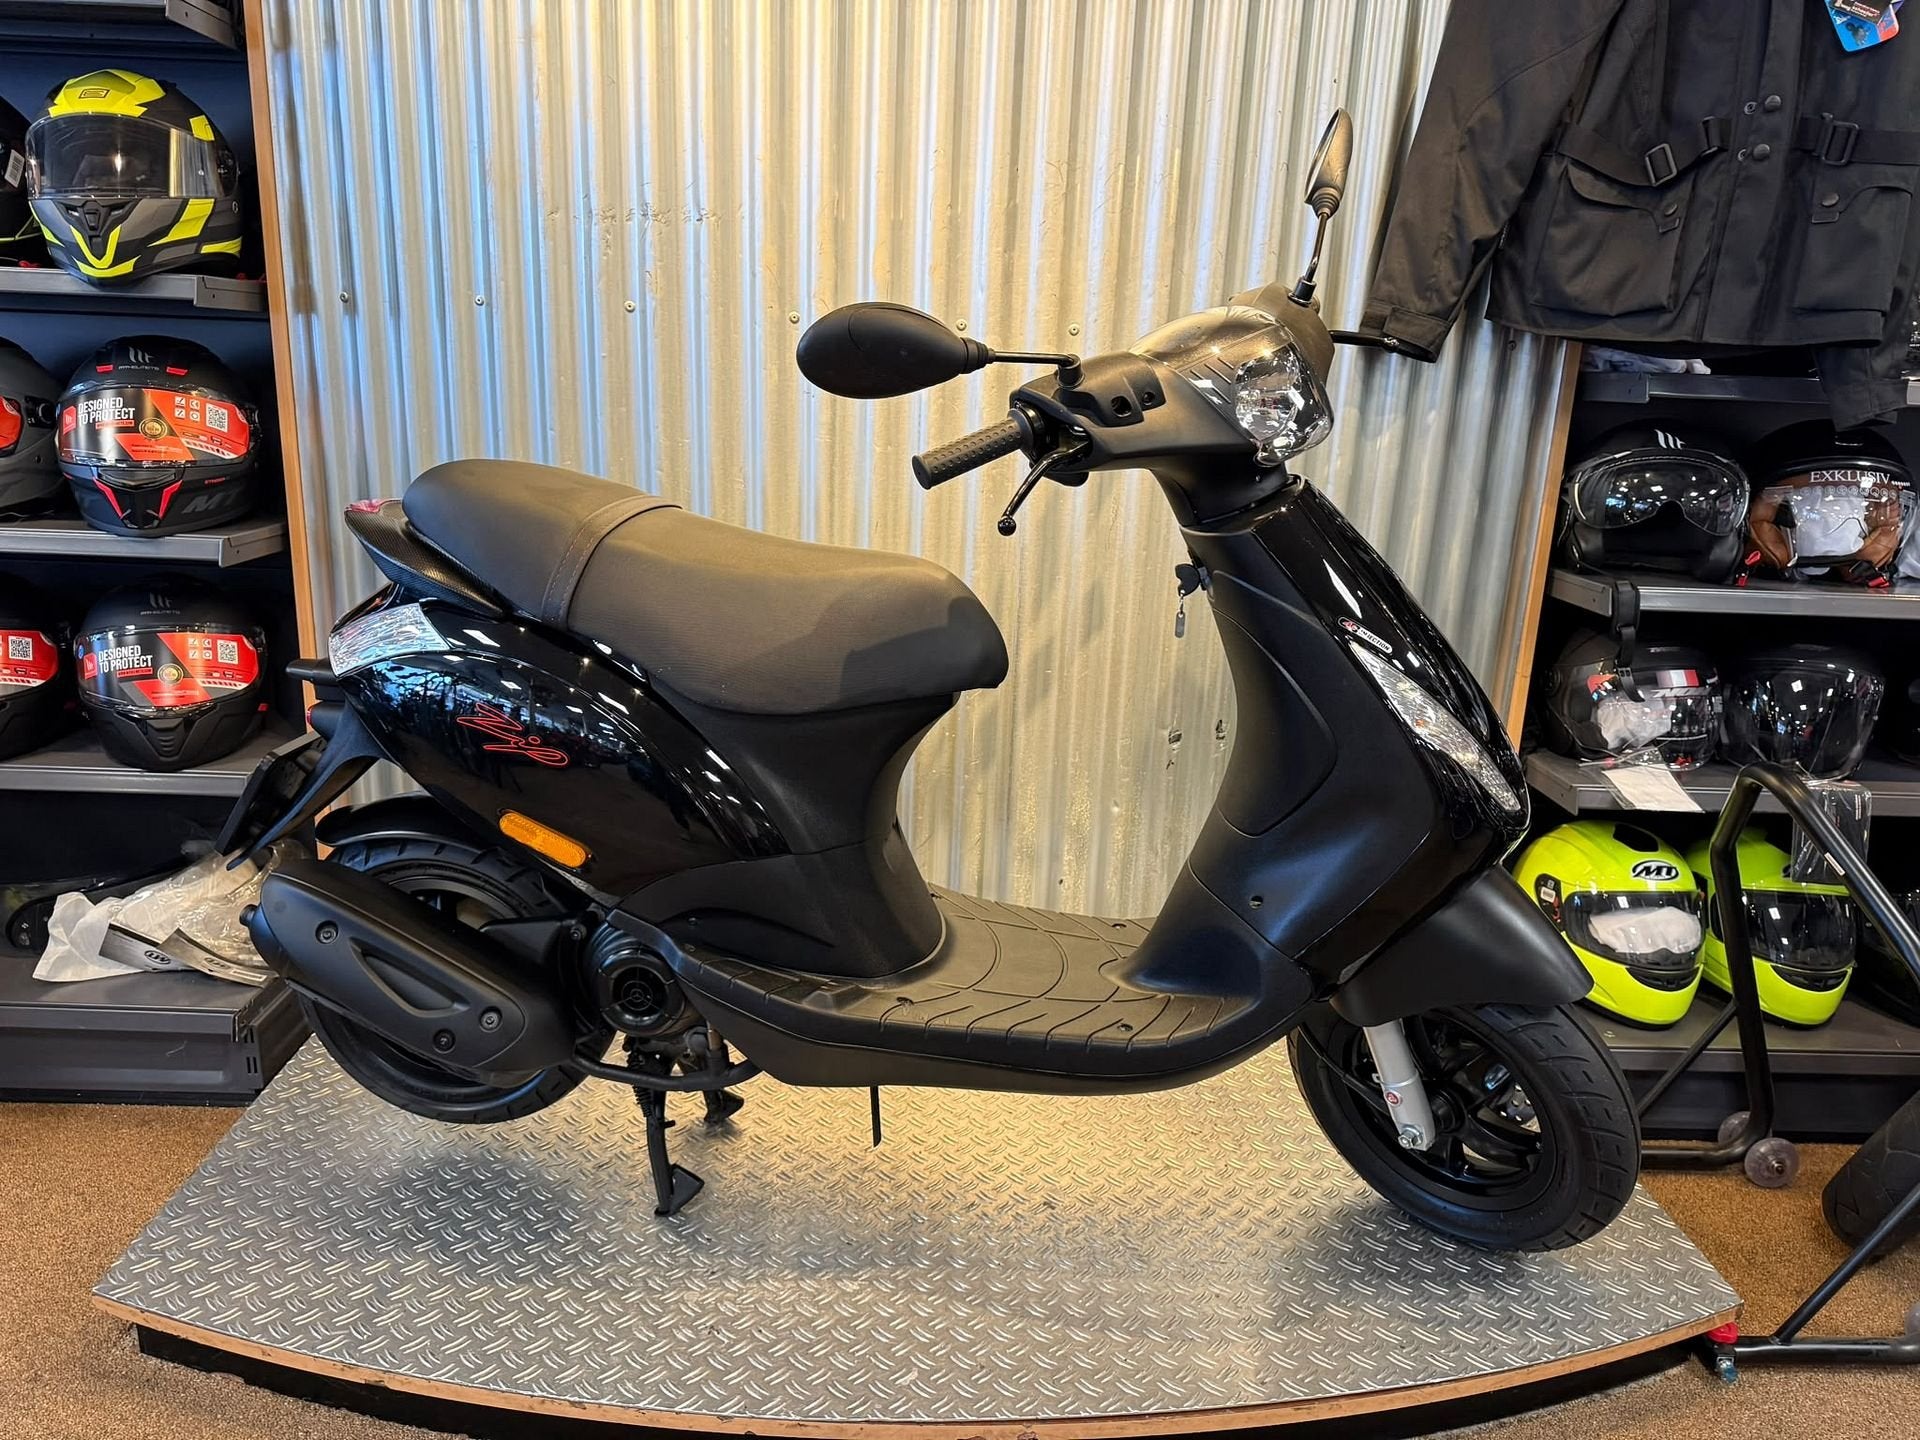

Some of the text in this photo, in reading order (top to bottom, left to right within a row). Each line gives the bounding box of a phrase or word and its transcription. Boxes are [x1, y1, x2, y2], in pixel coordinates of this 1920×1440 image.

[78, 397, 123, 414] DESIGNED
[78, 413, 89, 425] TO
[90, 408, 135, 423] PROTECT
[1809, 470, 1890, 484] EXKLUSIV
[98, 645, 141, 661] DESIGNED
[99, 655, 153, 673] TO PROTECT
[1632, 863, 1677, 880] MT
